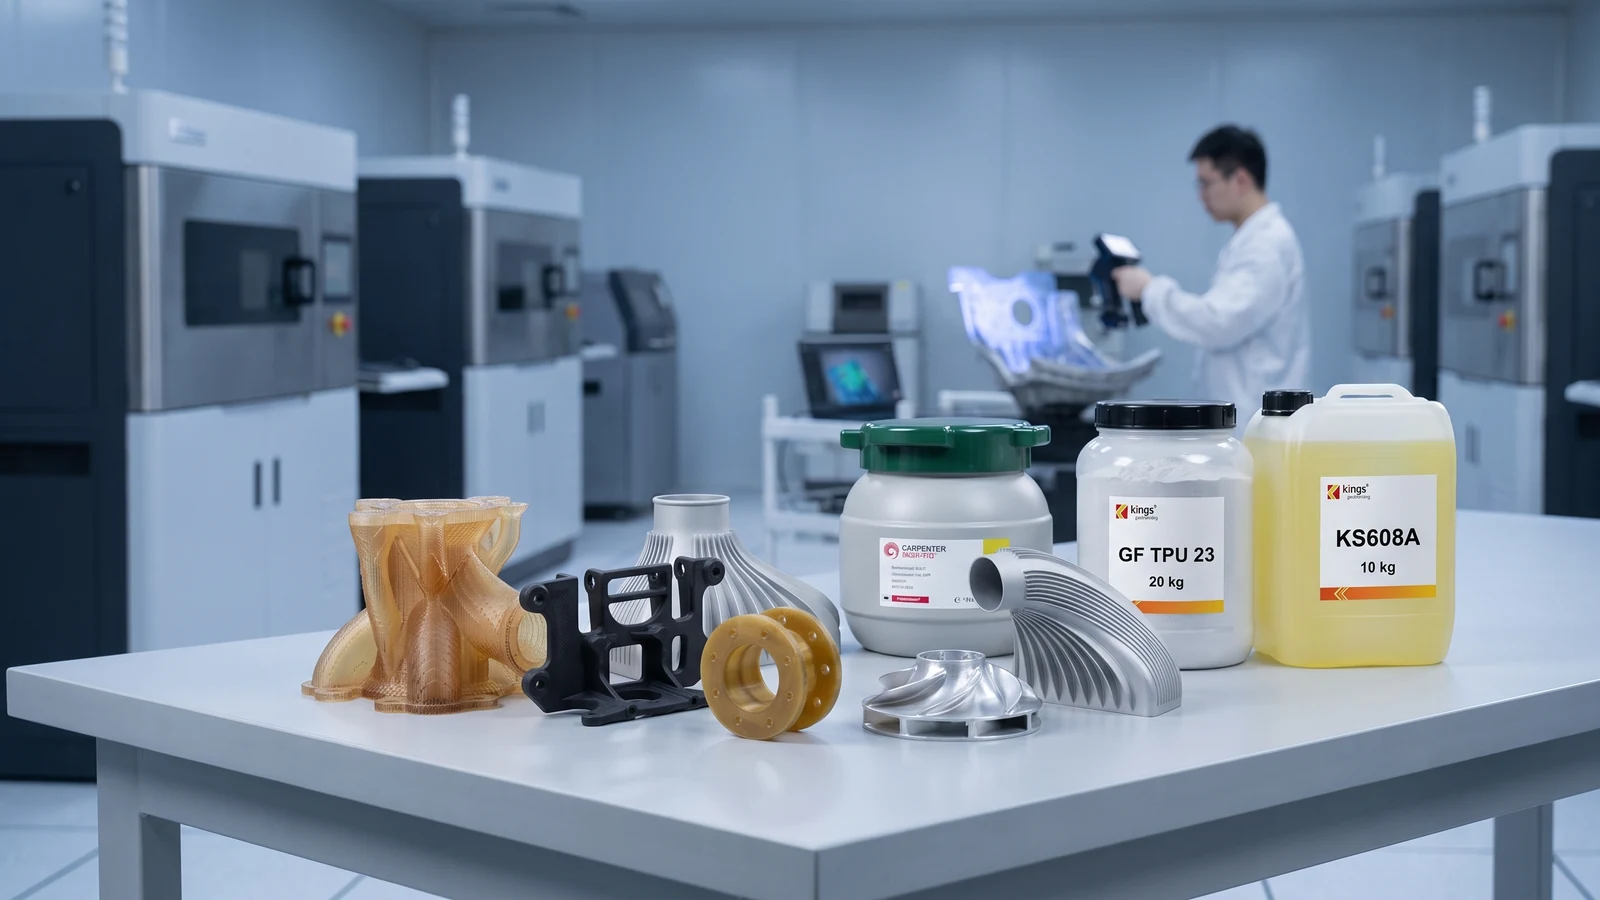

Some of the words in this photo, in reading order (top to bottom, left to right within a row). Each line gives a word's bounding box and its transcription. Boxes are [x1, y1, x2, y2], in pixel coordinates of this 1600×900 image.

[1336, 528, 1421, 547] KS608A
[1118, 547, 1145, 562] GF
[1150, 547, 1188, 562] TPU
[1193, 547, 1215, 562] 23
[1360, 561, 1376, 573] 10
[1379, 561, 1396, 576] kg
[1149, 576, 1164, 587] 20
[1168, 576, 1184, 590] kg
